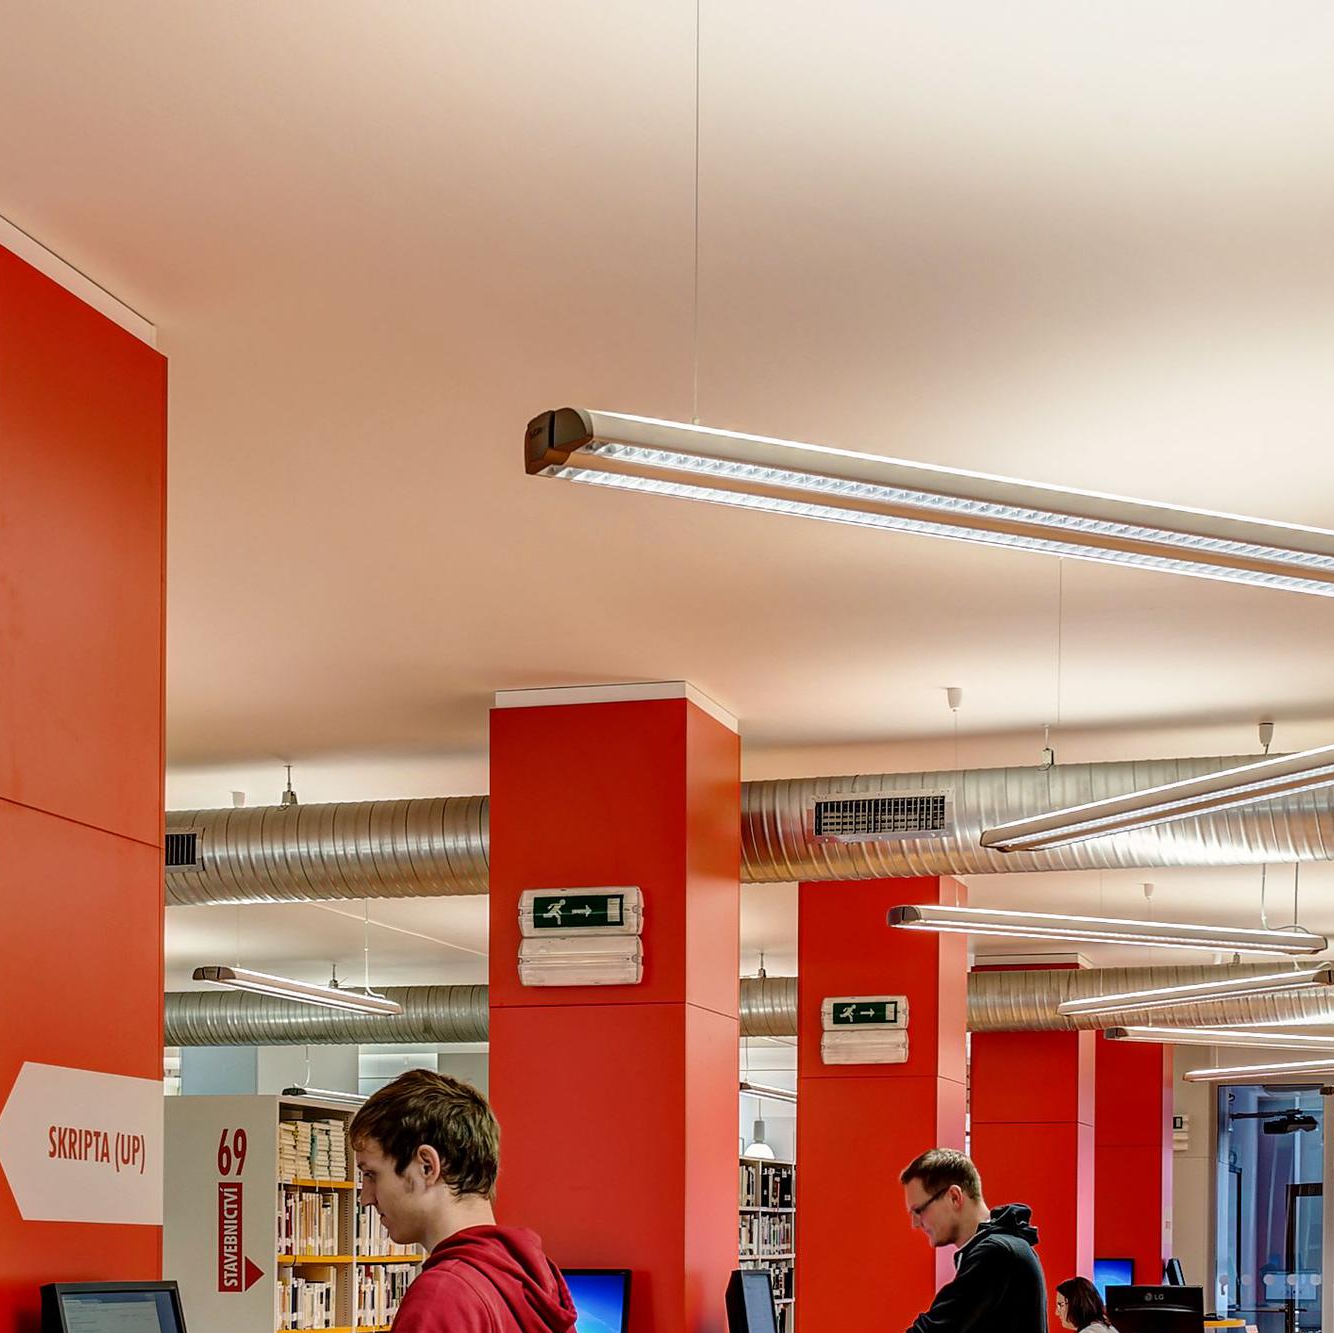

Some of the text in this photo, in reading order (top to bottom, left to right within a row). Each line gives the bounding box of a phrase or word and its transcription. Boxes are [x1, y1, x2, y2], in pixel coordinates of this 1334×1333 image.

[48, 1125, 145, 1174] SKRIPTA (UP)
[218, 1128, 247, 1176] 69
[220, 1187, 238, 1287] STAVEBNICTVÍ
